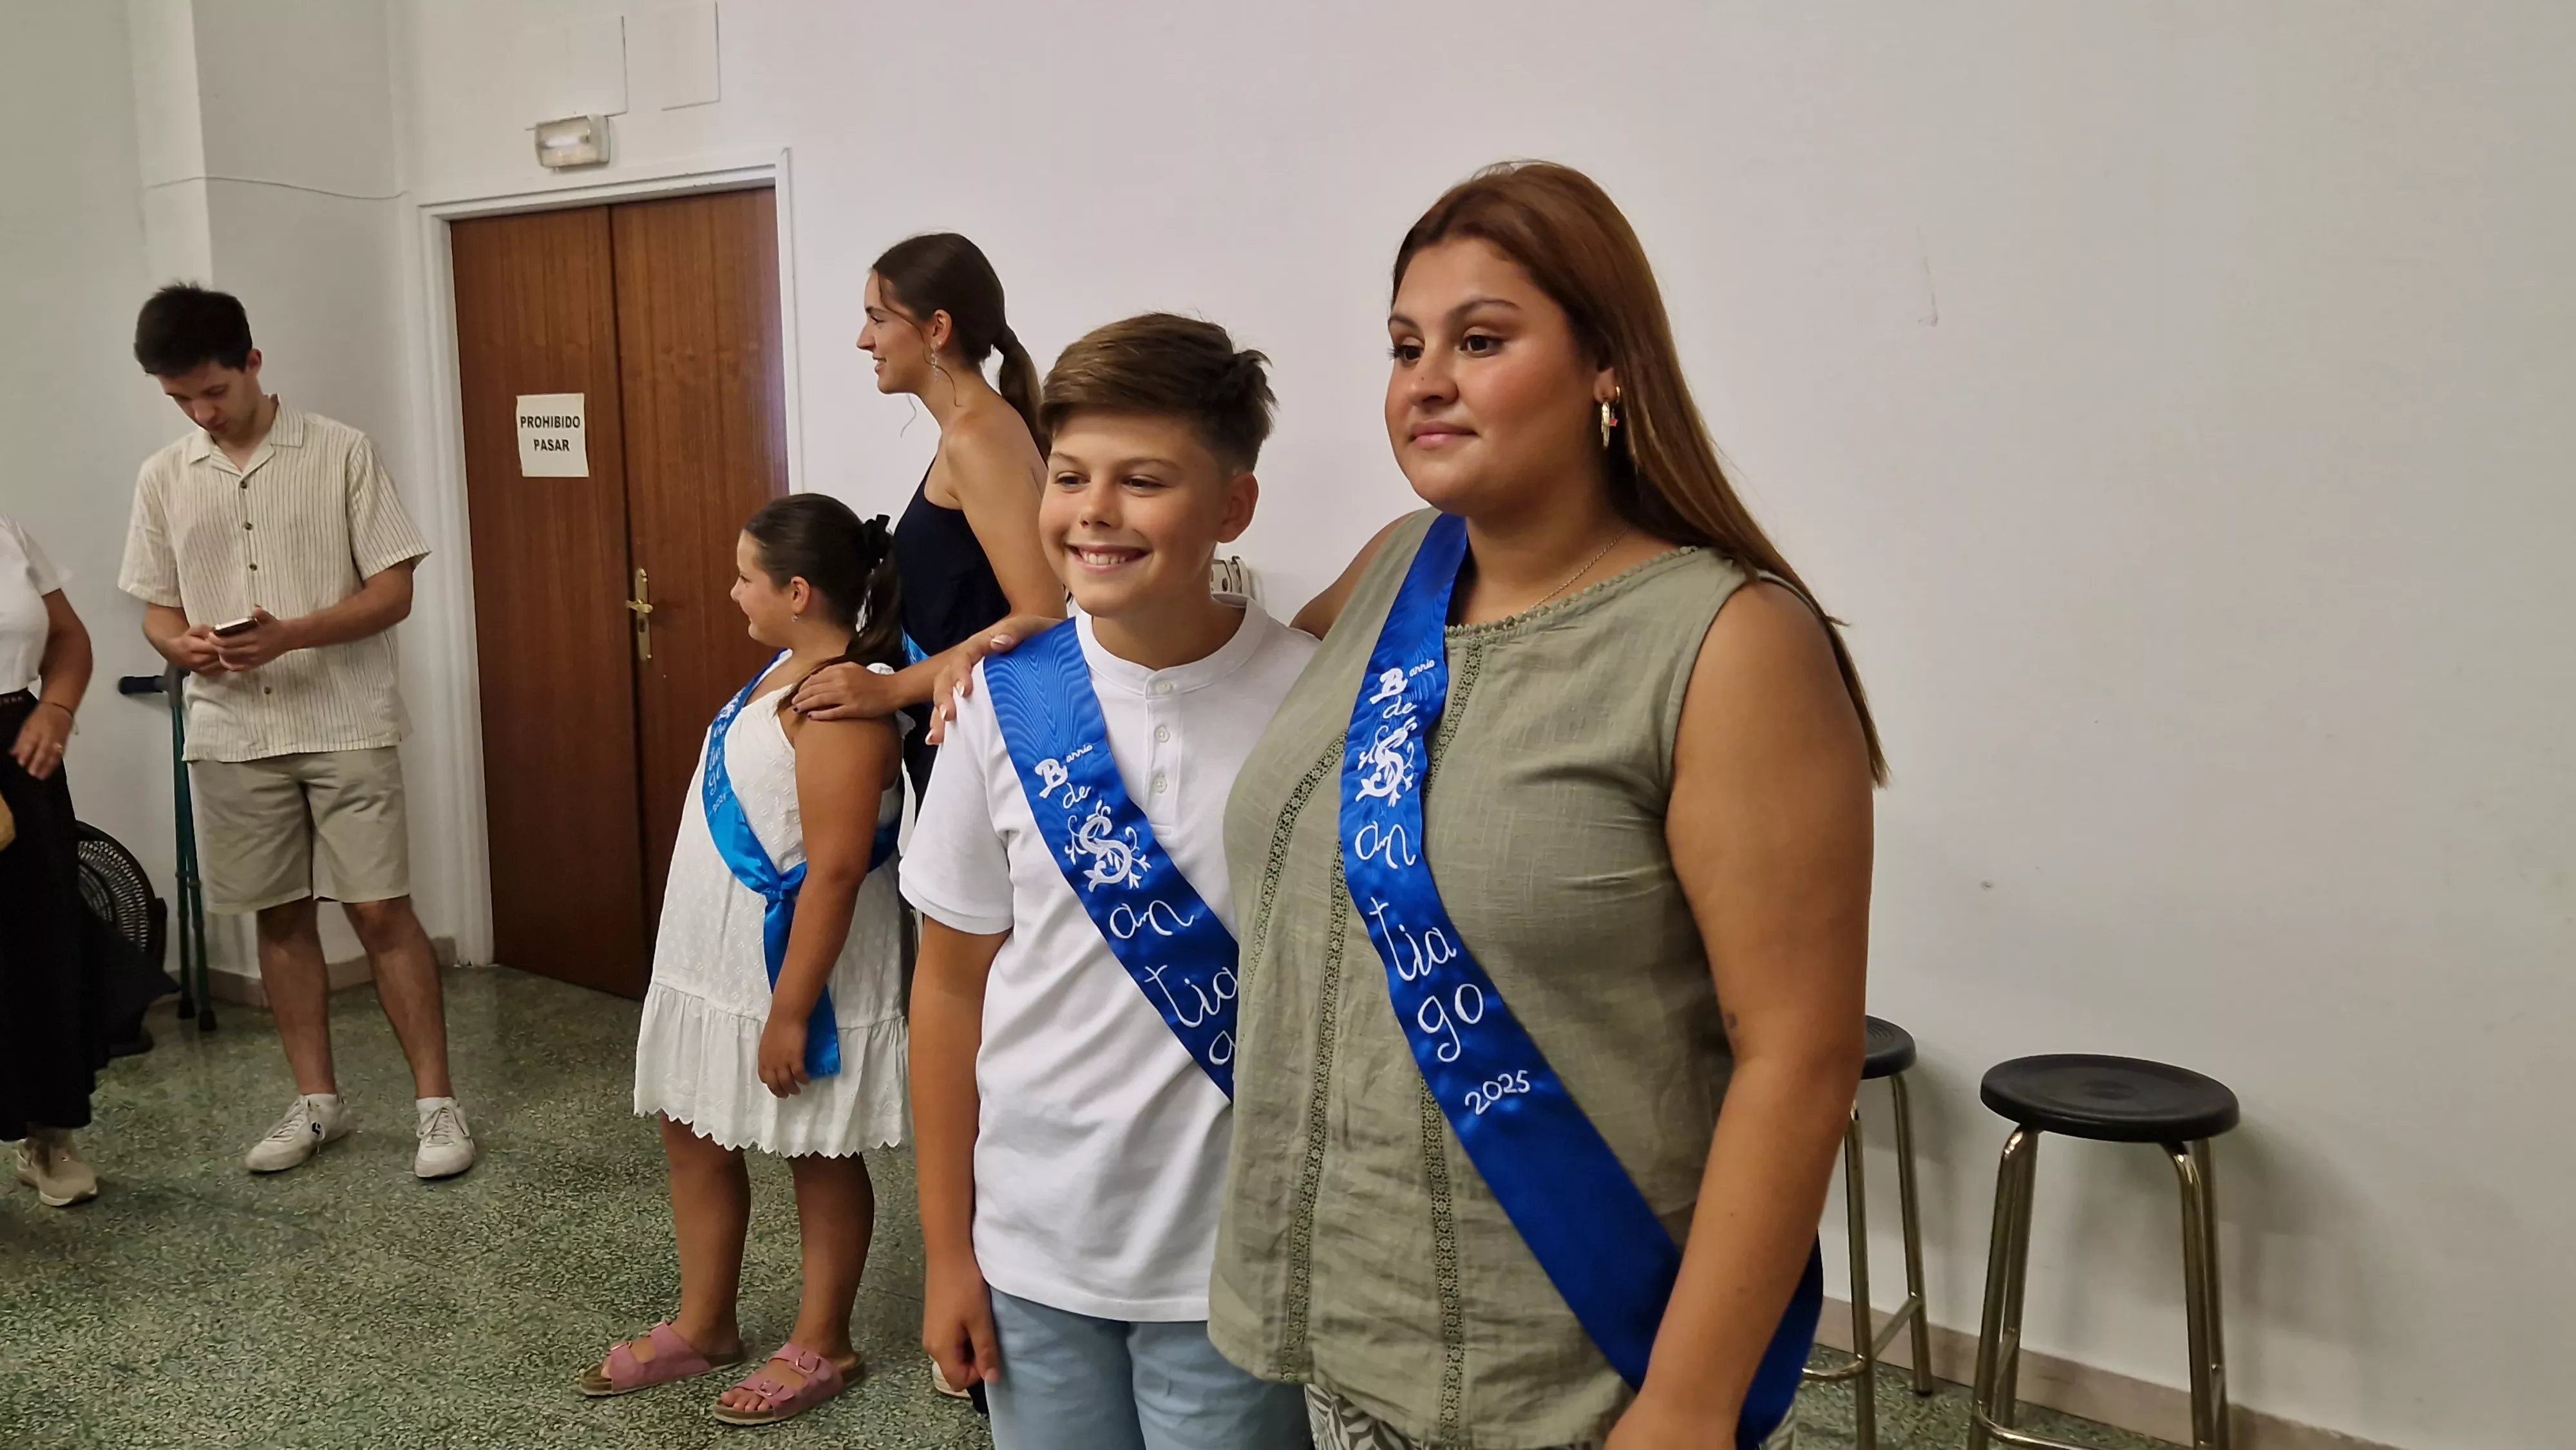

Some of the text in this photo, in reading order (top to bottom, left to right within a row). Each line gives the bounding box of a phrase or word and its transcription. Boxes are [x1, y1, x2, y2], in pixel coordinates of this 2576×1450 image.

[520, 415, 581, 429] PROHIBIDO
[533, 438, 571, 451] PASAR
[1382, 695, 1417, 719] de
[1464, 1069, 1530, 1115] 2025
